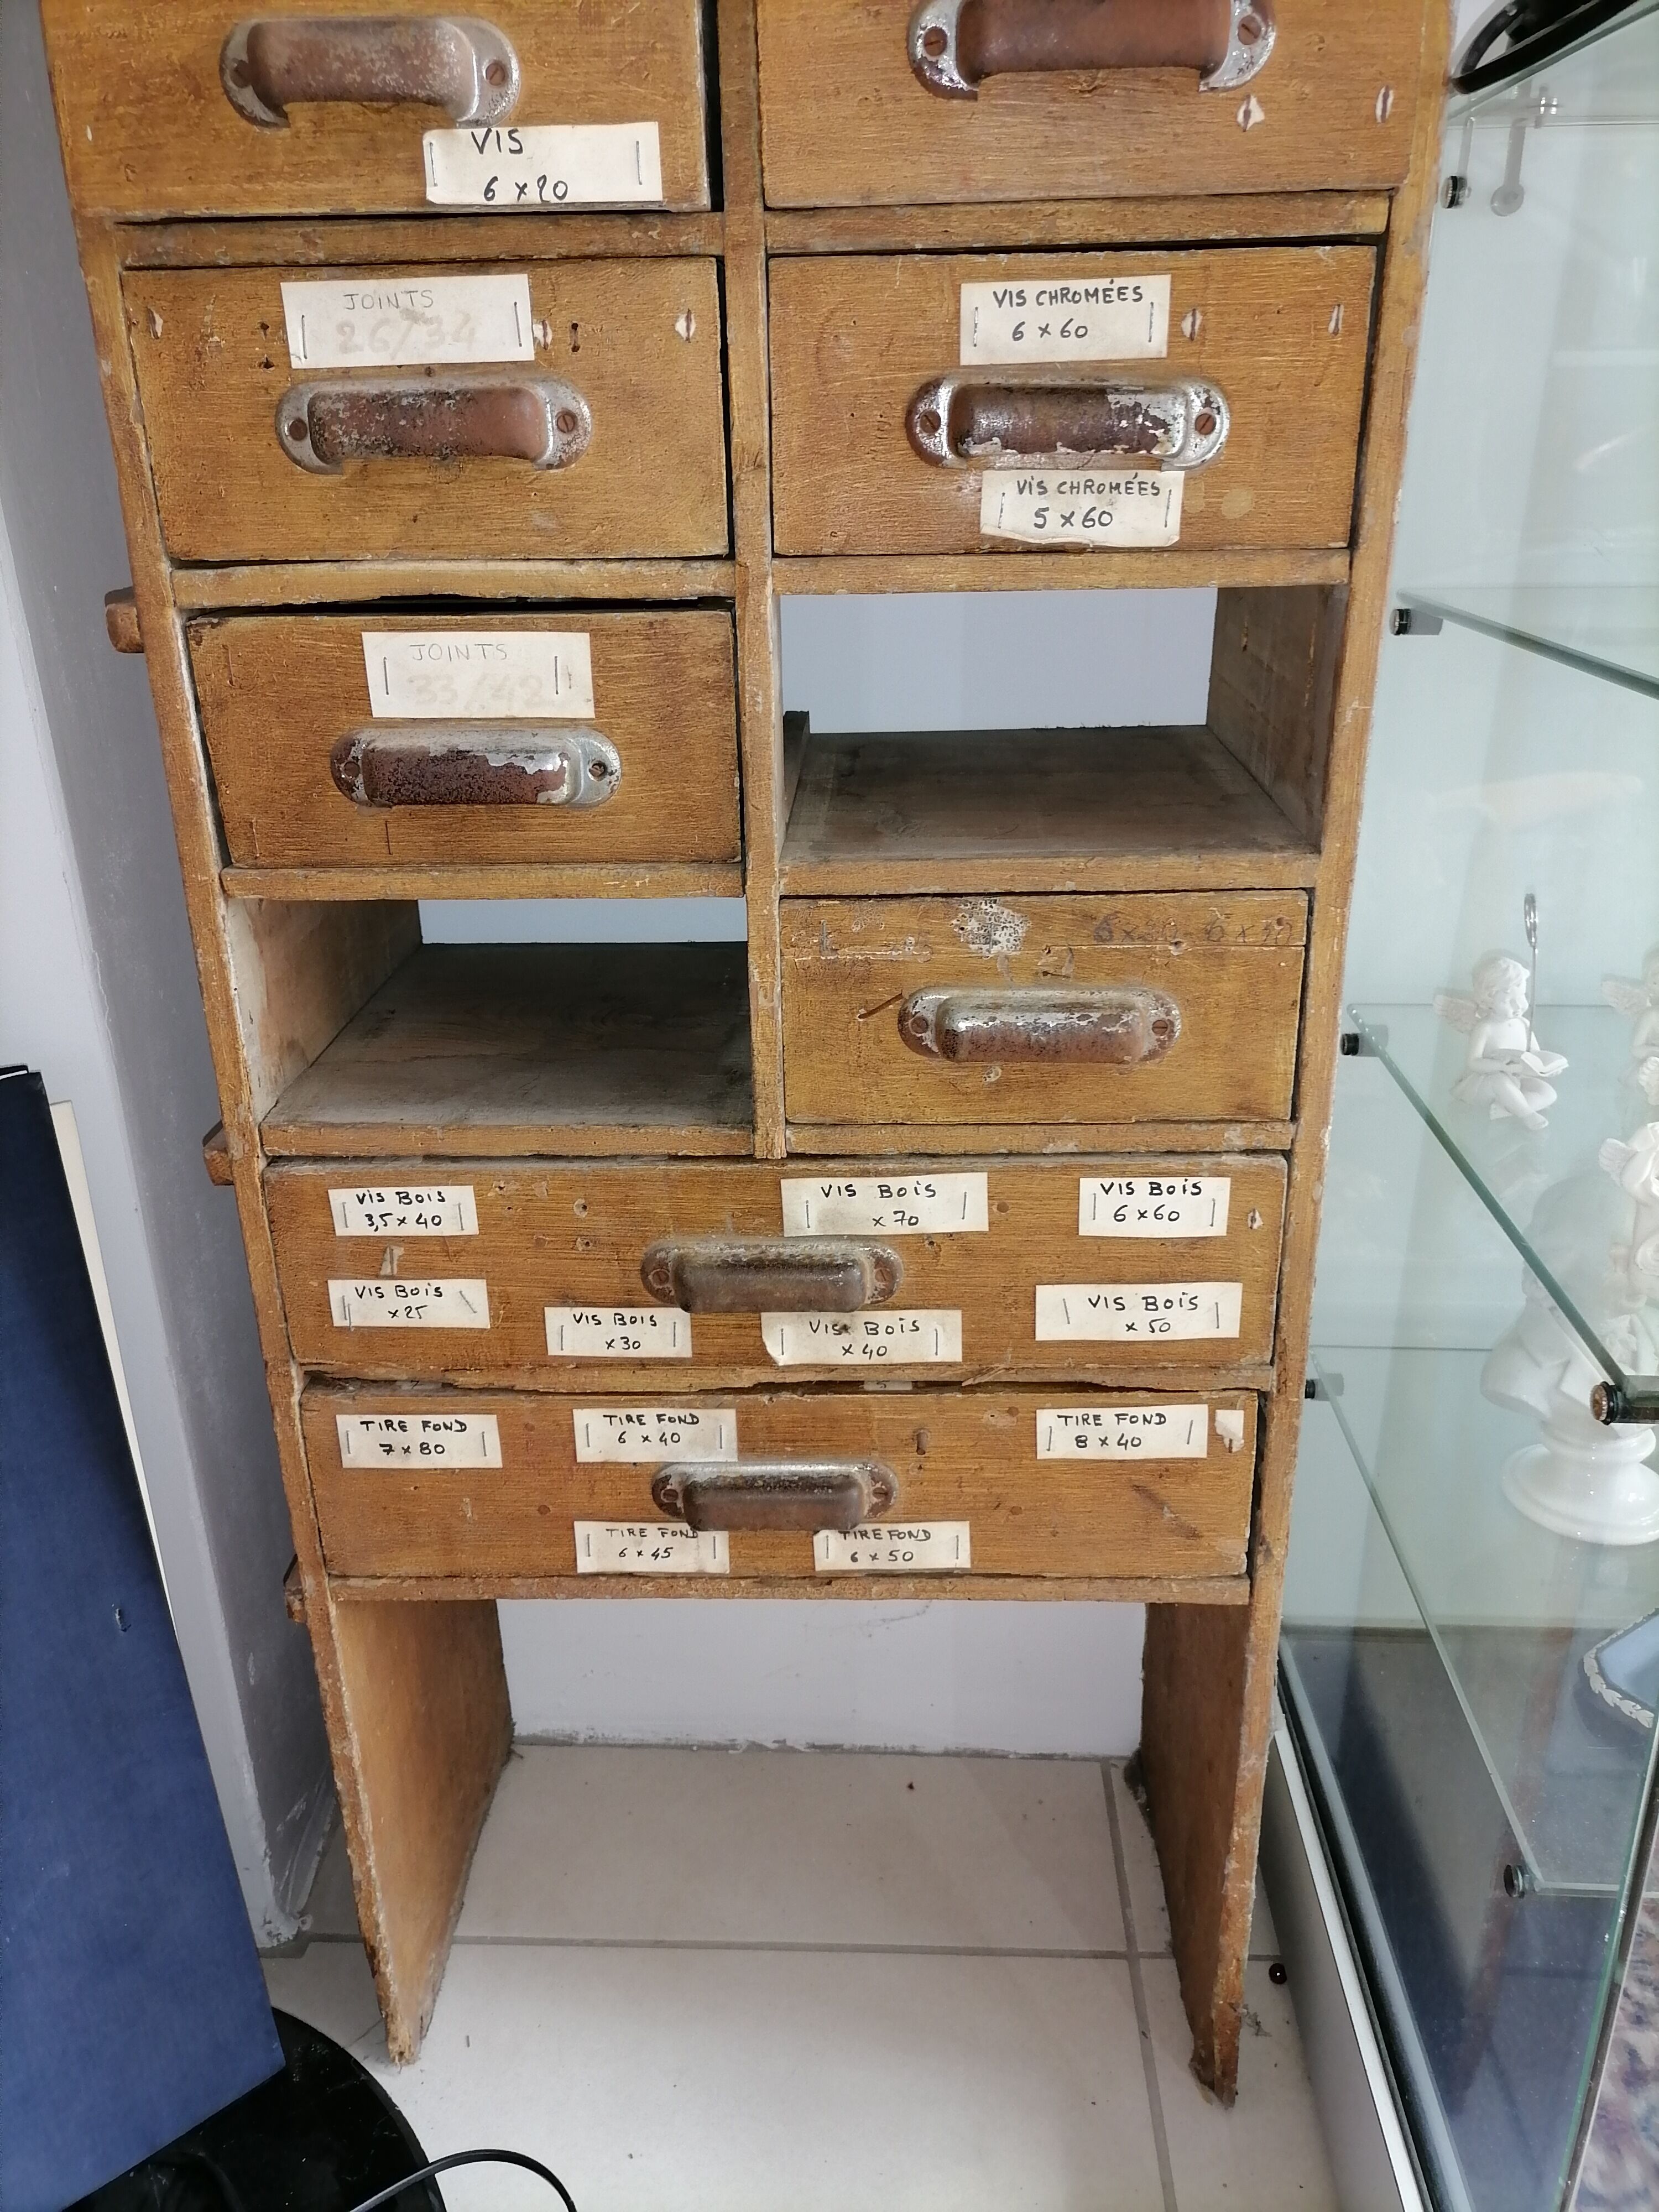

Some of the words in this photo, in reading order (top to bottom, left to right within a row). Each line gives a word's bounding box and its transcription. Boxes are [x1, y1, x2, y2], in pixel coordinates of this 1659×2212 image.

[469, 126, 526, 155] VIS
[343, 290, 434, 312] JOINTS
[992, 288, 1027, 309] VIS
[1035, 278, 1144, 307] CHROMÉES
[1056, 472, 1161, 496] CHROMÉES
[409, 643, 507, 662] JOINTS
[821, 1183, 857, 1198] VIS
[1100, 1181, 1135, 1196] VIS
[354, 1285, 385, 1299] VIS
[1088, 1294, 1125, 1311] VIS
[572, 1312, 602, 1326] VIS
[809, 1319, 844, 1336] VIS
[359, 1419, 408, 1432] TIRE
[421, 1418, 467, 1433] FOND
[602, 1413, 646, 1426] TIRE
[656, 1412, 700, 1425] FOND
[1057, 1413, 1103, 1427] TIRE
[1114, 1412, 1167, 1426] FOND
[606, 1528, 648, 1538] TIRE
